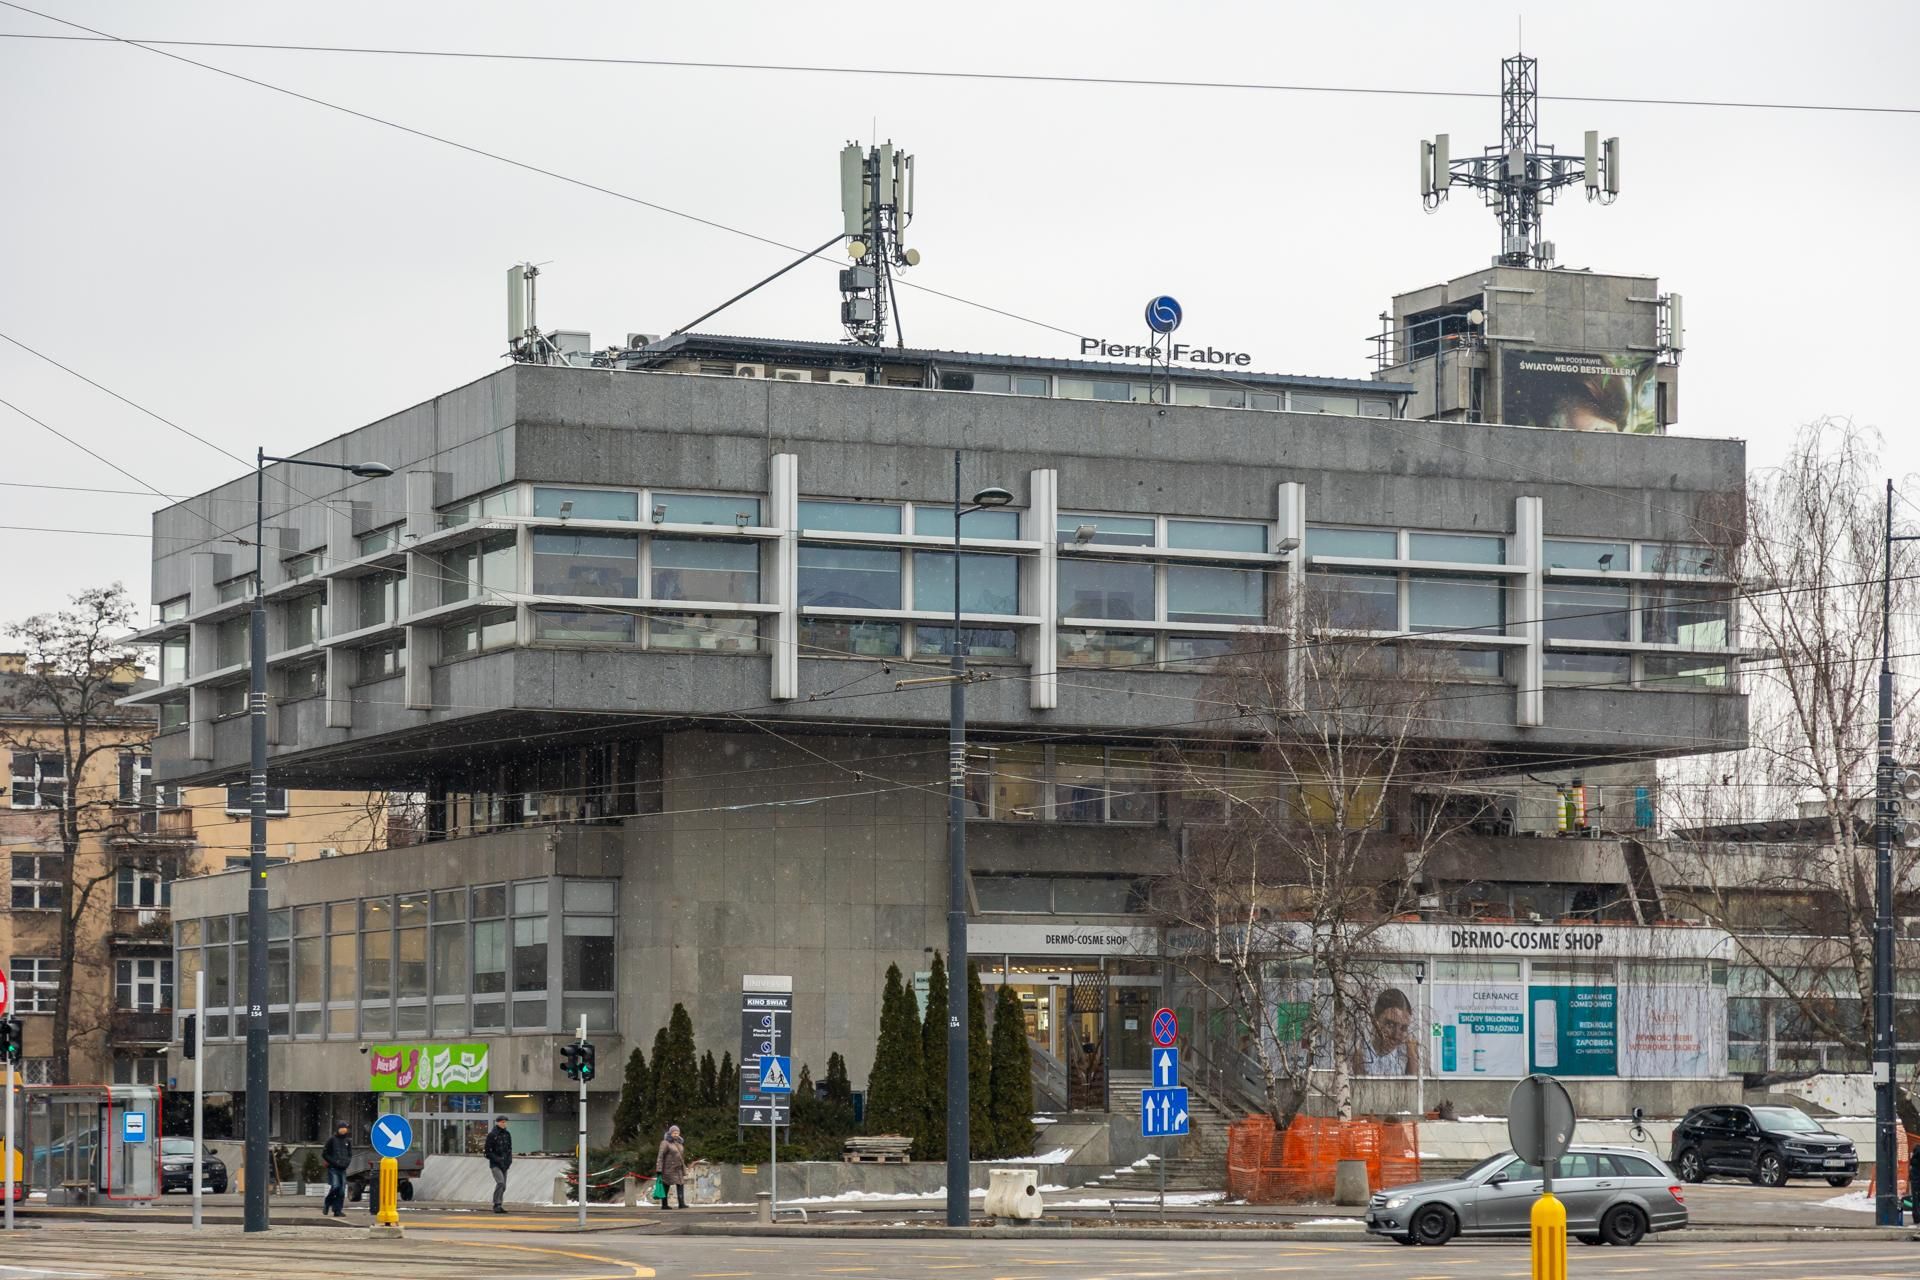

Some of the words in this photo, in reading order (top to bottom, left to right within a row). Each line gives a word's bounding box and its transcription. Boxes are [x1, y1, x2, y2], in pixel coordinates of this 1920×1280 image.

[1080, 338, 1162, 359] Pierre
[1173, 344, 1251, 366] Fabre
[1519, 360, 1578, 373] ŚWIATOWEGO
[1580, 366, 1637, 377] BESTSELLERA
[1566, 357, 1601, 365] PODSTAWIE
[1045, 934, 1104, 945] DERMO-COSME
[1106, 935, 1128, 945] SHOP
[1451, 931, 1560, 950] DERMO-COSME
[1565, 933, 1604, 951] SHOP
